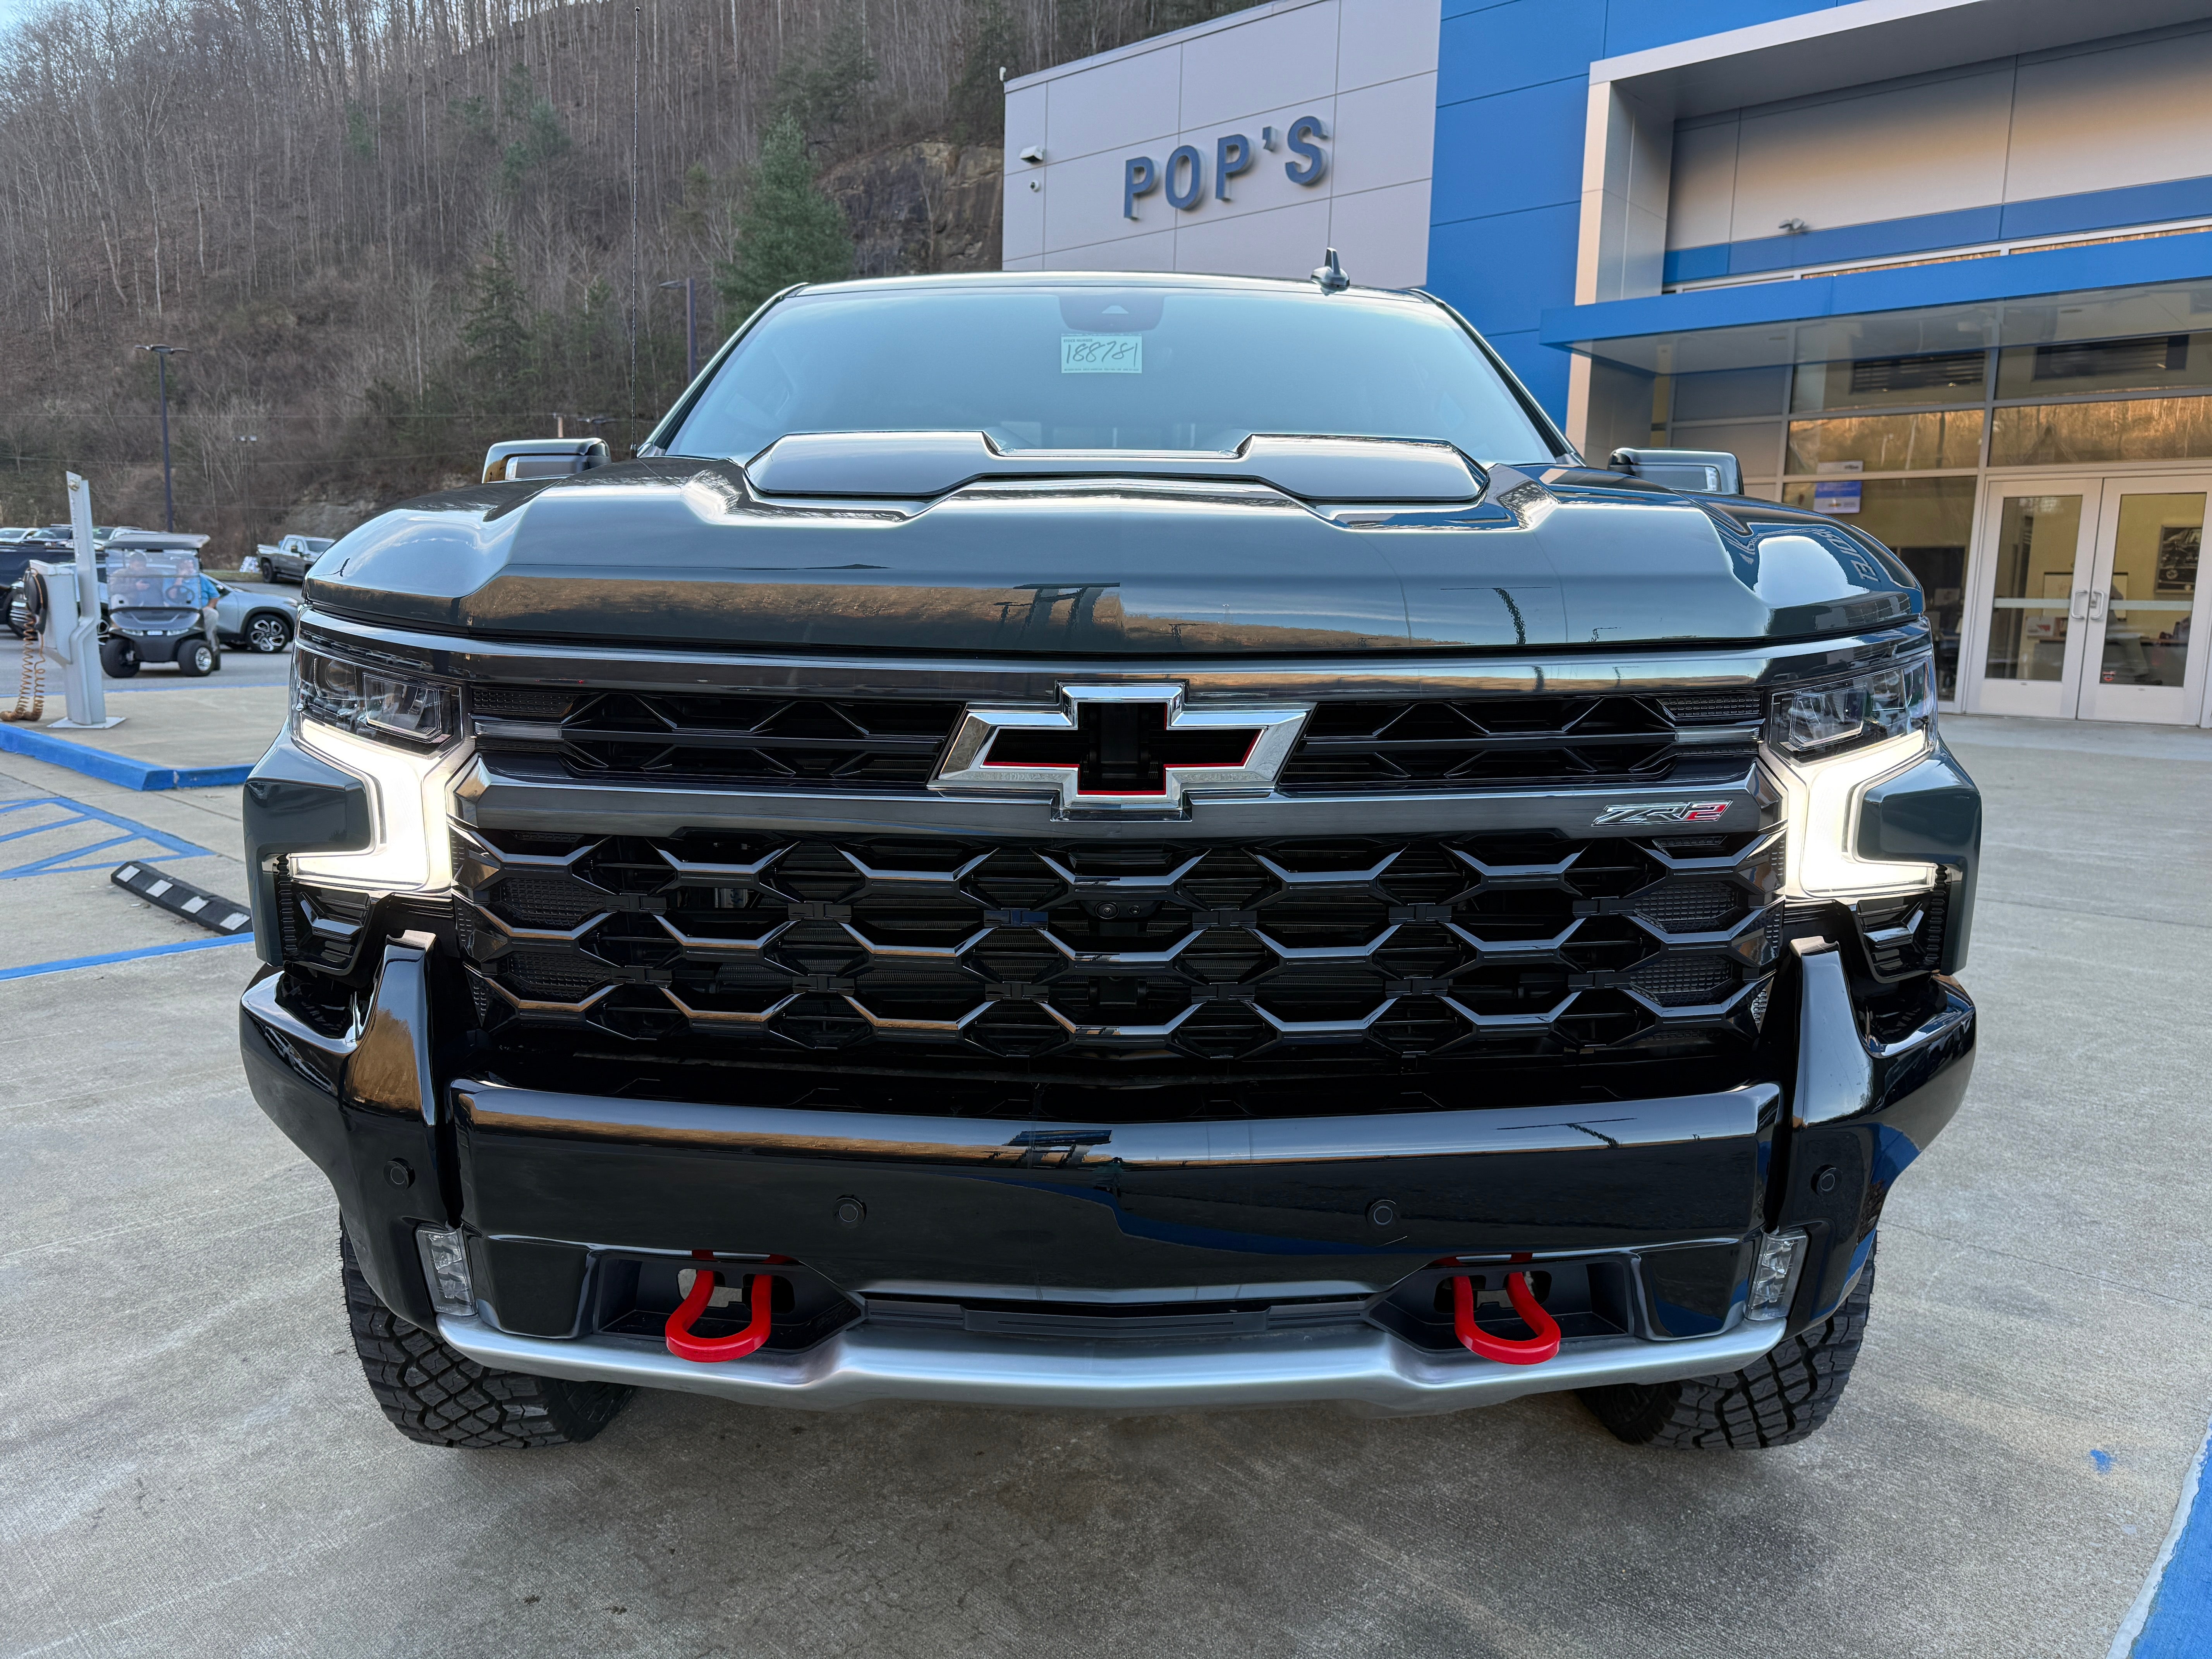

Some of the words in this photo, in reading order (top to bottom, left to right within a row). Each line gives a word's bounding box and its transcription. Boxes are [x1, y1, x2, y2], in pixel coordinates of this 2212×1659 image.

[1124, 116, 1328, 220] POP'S
[1066, 341, 1137, 367] 188781
[1592, 800, 1732, 826] ZR2
